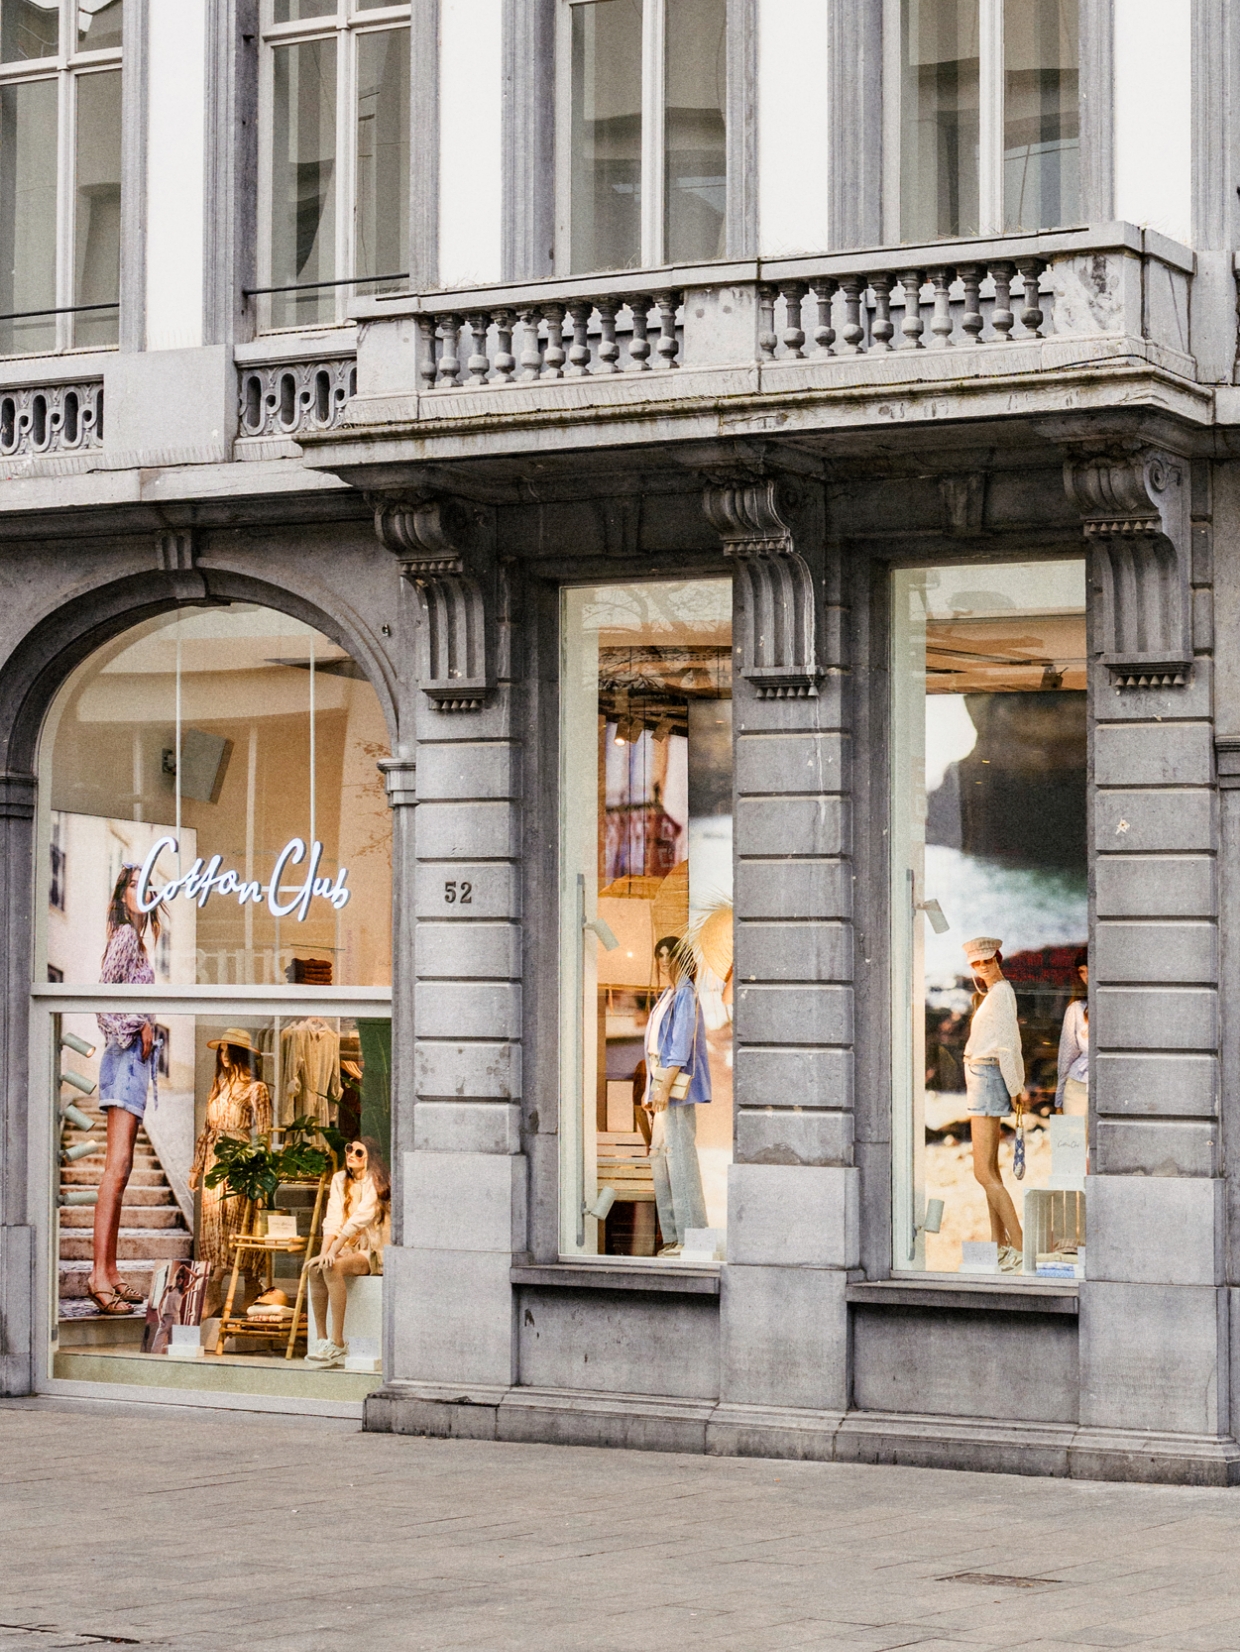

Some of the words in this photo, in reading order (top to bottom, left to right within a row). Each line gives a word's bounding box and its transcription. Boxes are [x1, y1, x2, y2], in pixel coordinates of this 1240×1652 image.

[136, 836, 264, 913] Cotton
[268, 837, 350, 922] Club
[444, 881, 472, 904] 52
